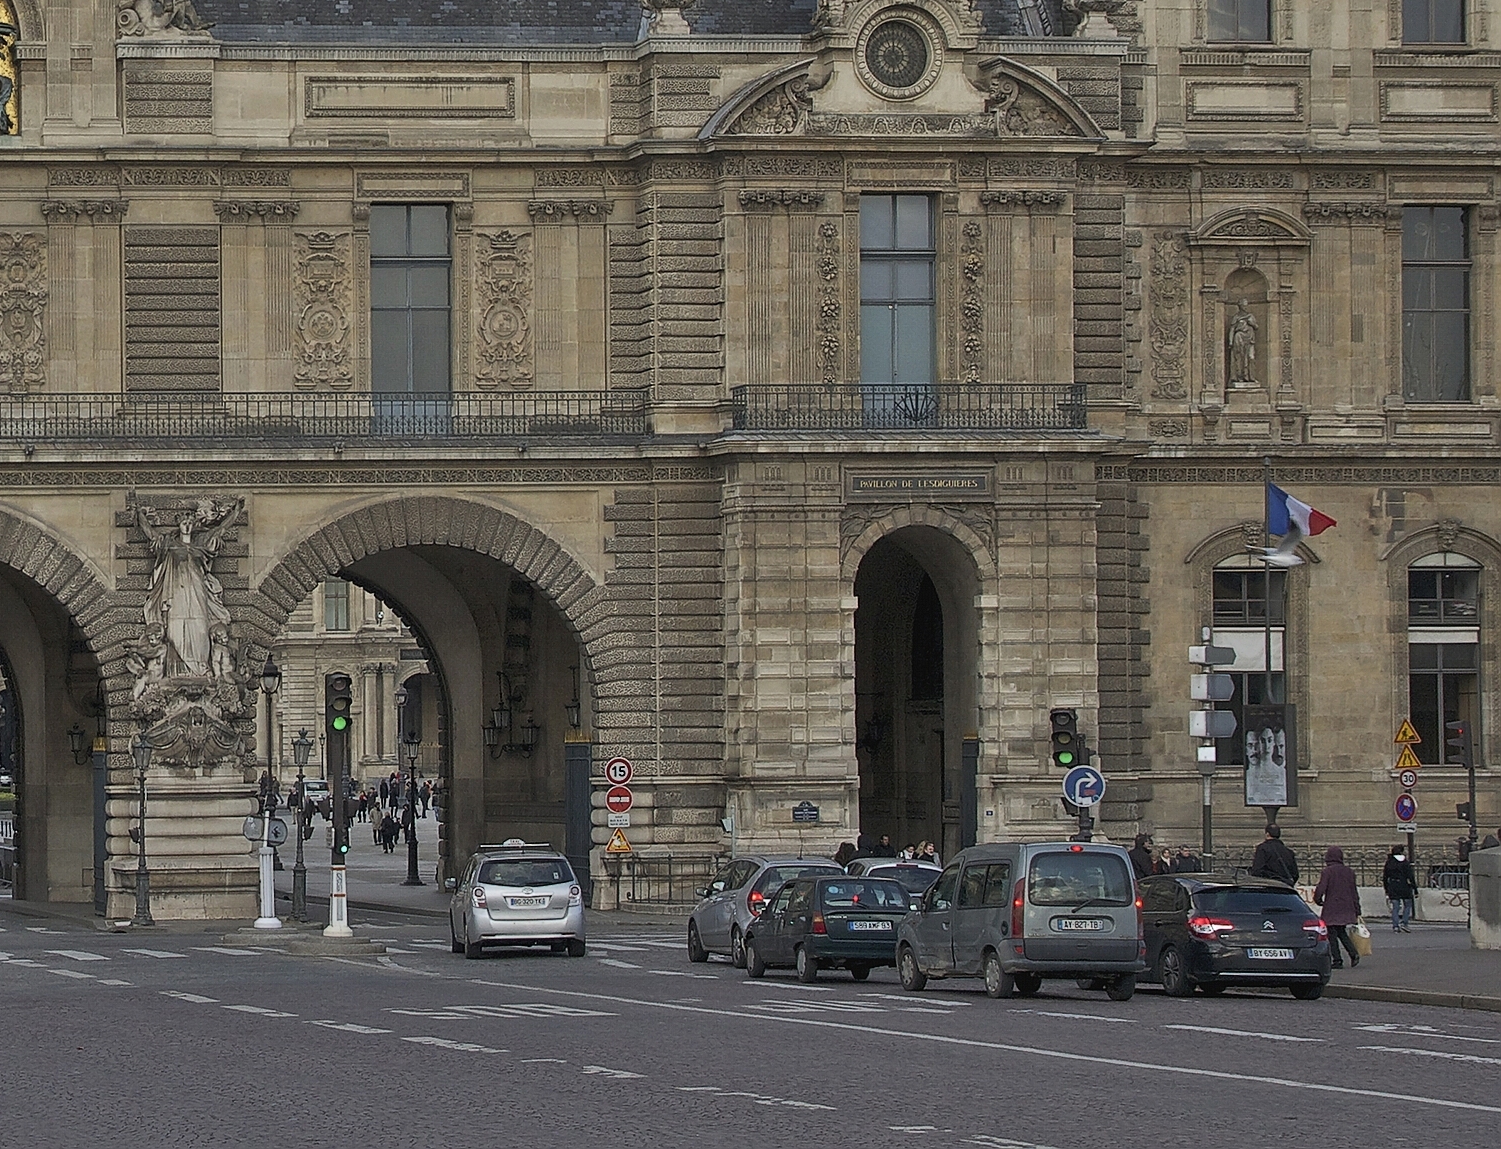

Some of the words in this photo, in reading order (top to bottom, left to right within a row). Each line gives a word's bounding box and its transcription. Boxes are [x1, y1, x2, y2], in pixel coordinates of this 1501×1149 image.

[860, 479, 898, 488] PAVILLON
[901, 479, 913, 488] DE
[611, 765, 626, 777] 15
[1403, 774, 1414, 783] 30
